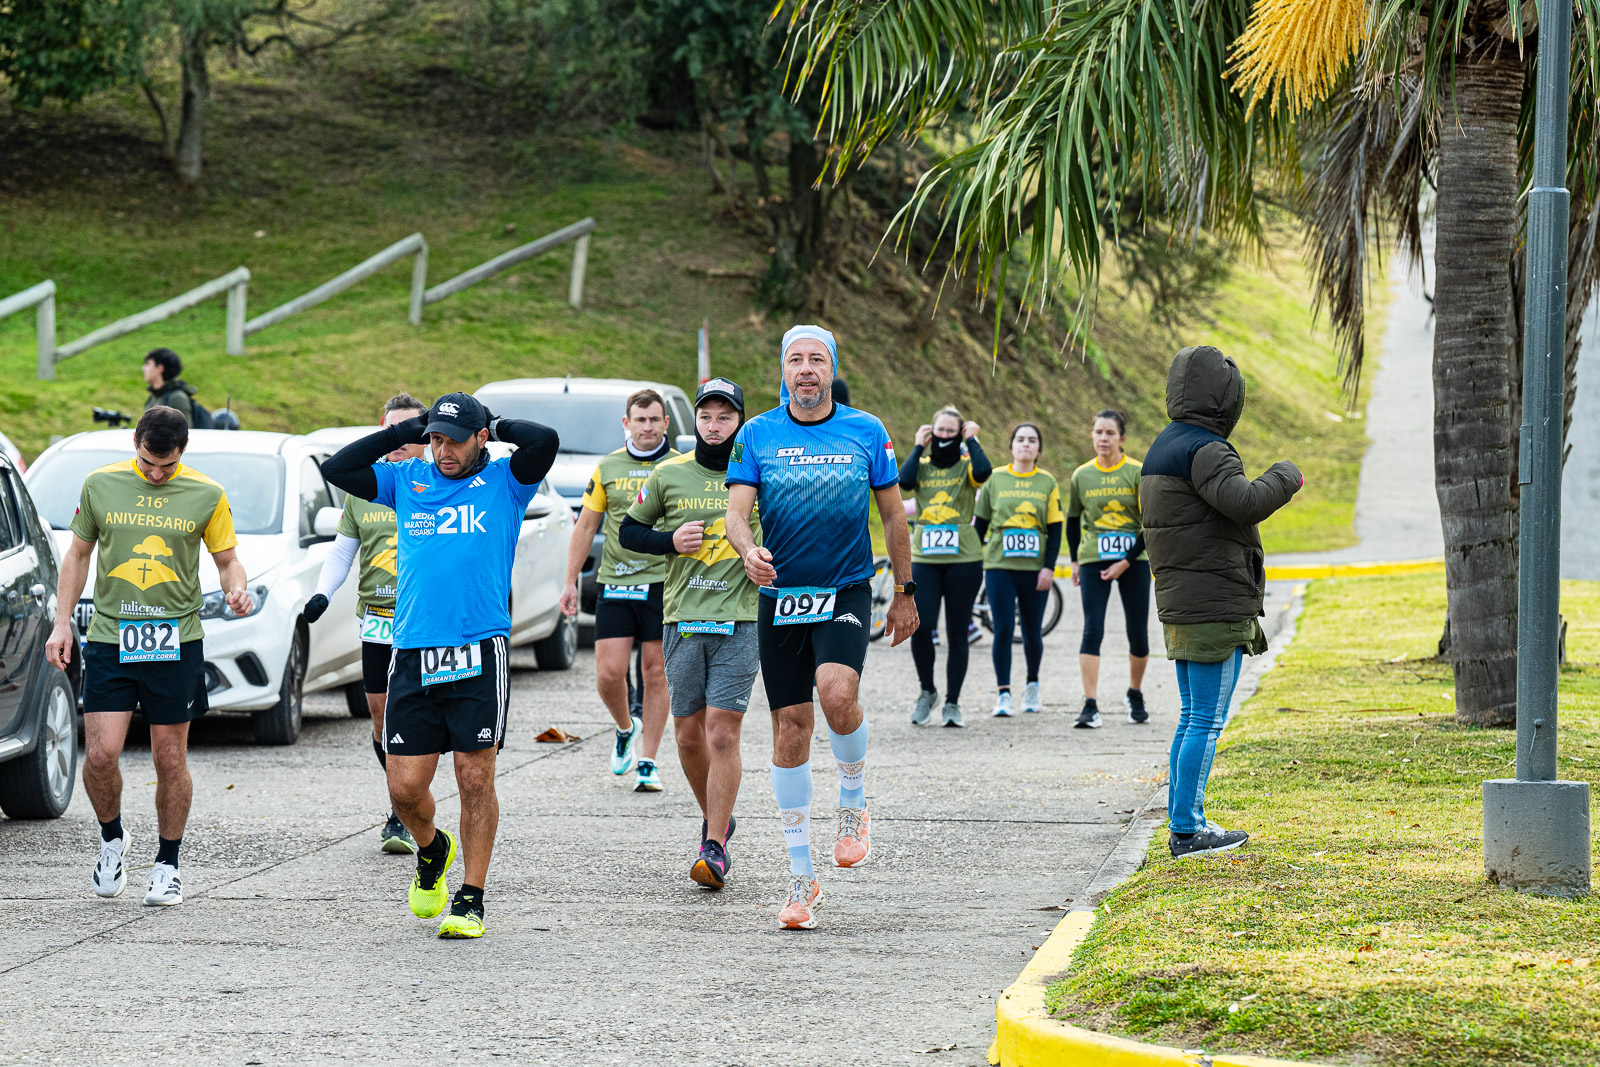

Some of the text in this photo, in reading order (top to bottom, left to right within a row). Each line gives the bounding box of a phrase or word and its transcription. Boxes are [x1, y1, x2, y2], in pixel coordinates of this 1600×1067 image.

[776, 447, 805, 458] SIN
[788, 454, 854, 466] LIMITES
[615, 478, 646, 491] VICT
[704, 481, 728, 492] 216
[136, 495, 169, 509] 216°
[678, 498, 729, 510] ANIVERS
[105, 512, 196, 533] ANIVERSARIO
[362, 511, 397, 524] ANIVE
[411, 513, 436, 521] MEDIA
[926, 529, 955, 548] 122
[1006, 533, 1036, 551] 089
[1101, 535, 1132, 553] 040
[375, 585, 398, 597] julic
[119, 600, 165, 614] julicroc
[779, 592, 832, 618] 097
[74, 603, 96, 628] FIA
[776, 615, 830, 625] DIAMANTE CORRE
[363, 619, 392, 640] 20
[680, 625, 731, 634] DIAMANTE CORRE
[123, 622, 175, 653] 082
[122, 653, 155, 662] DIAMANTE
[423, 642, 473, 676] 041
[424, 669, 479, 685] DIAMANTE CORRE
